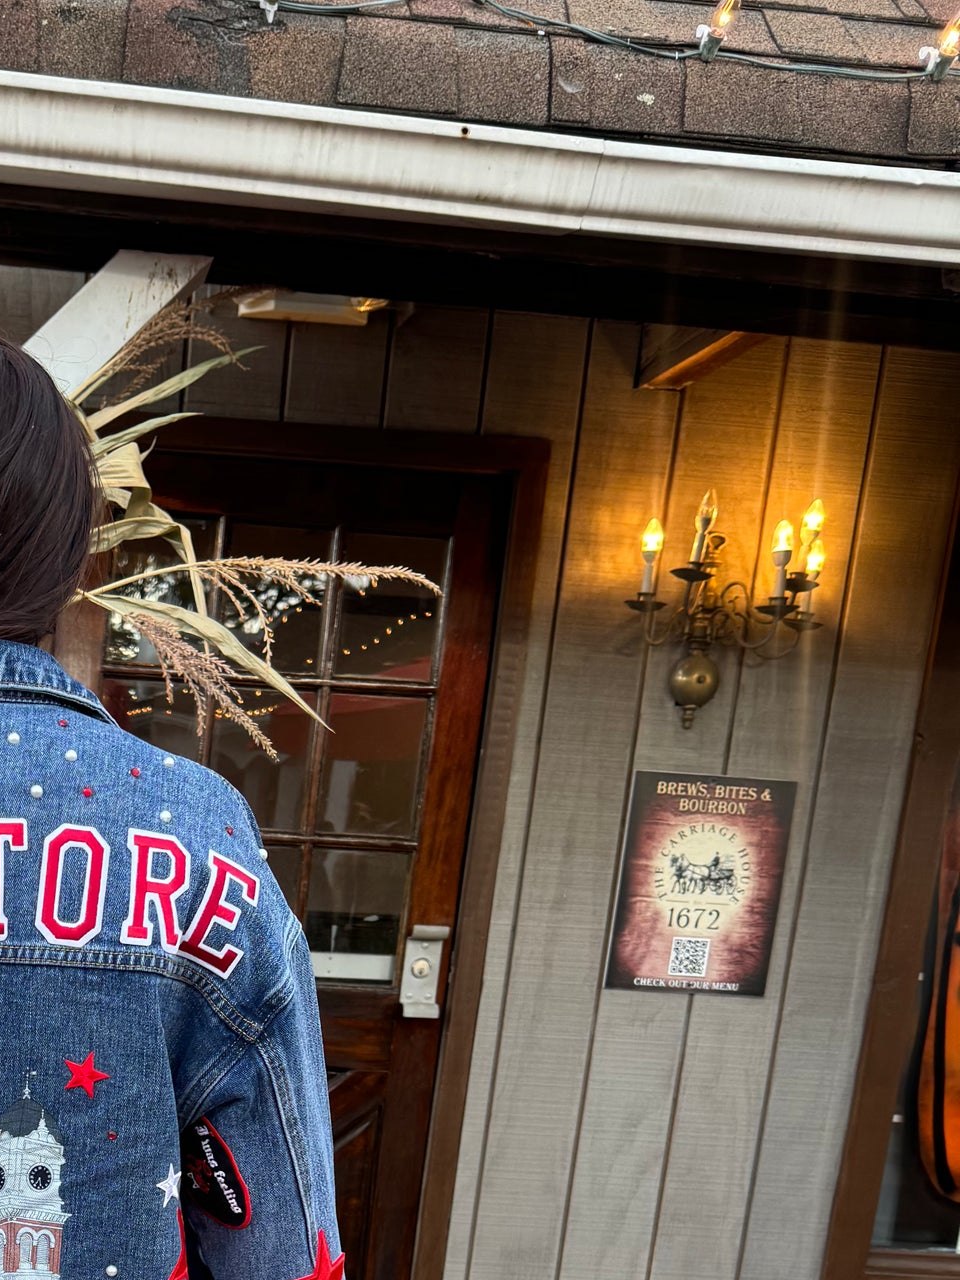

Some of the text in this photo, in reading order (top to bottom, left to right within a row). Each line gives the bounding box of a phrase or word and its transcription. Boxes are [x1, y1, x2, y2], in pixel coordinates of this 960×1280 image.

[715, 785, 758, 801] BITES
[760, 788, 772, 801] &
[679, 798, 748, 815] BOURBON
[654, 823, 752, 905] THE CARRIAGE HOUSE
[667, 907, 720, 930] 1672
[633, 977, 666, 987] CHECK
[668, 979, 687, 989] OUT
[710, 982, 740, 991] MENU
[201, 1138, 218, 1168] was
[213, 1170, 243, 1214] feeling
